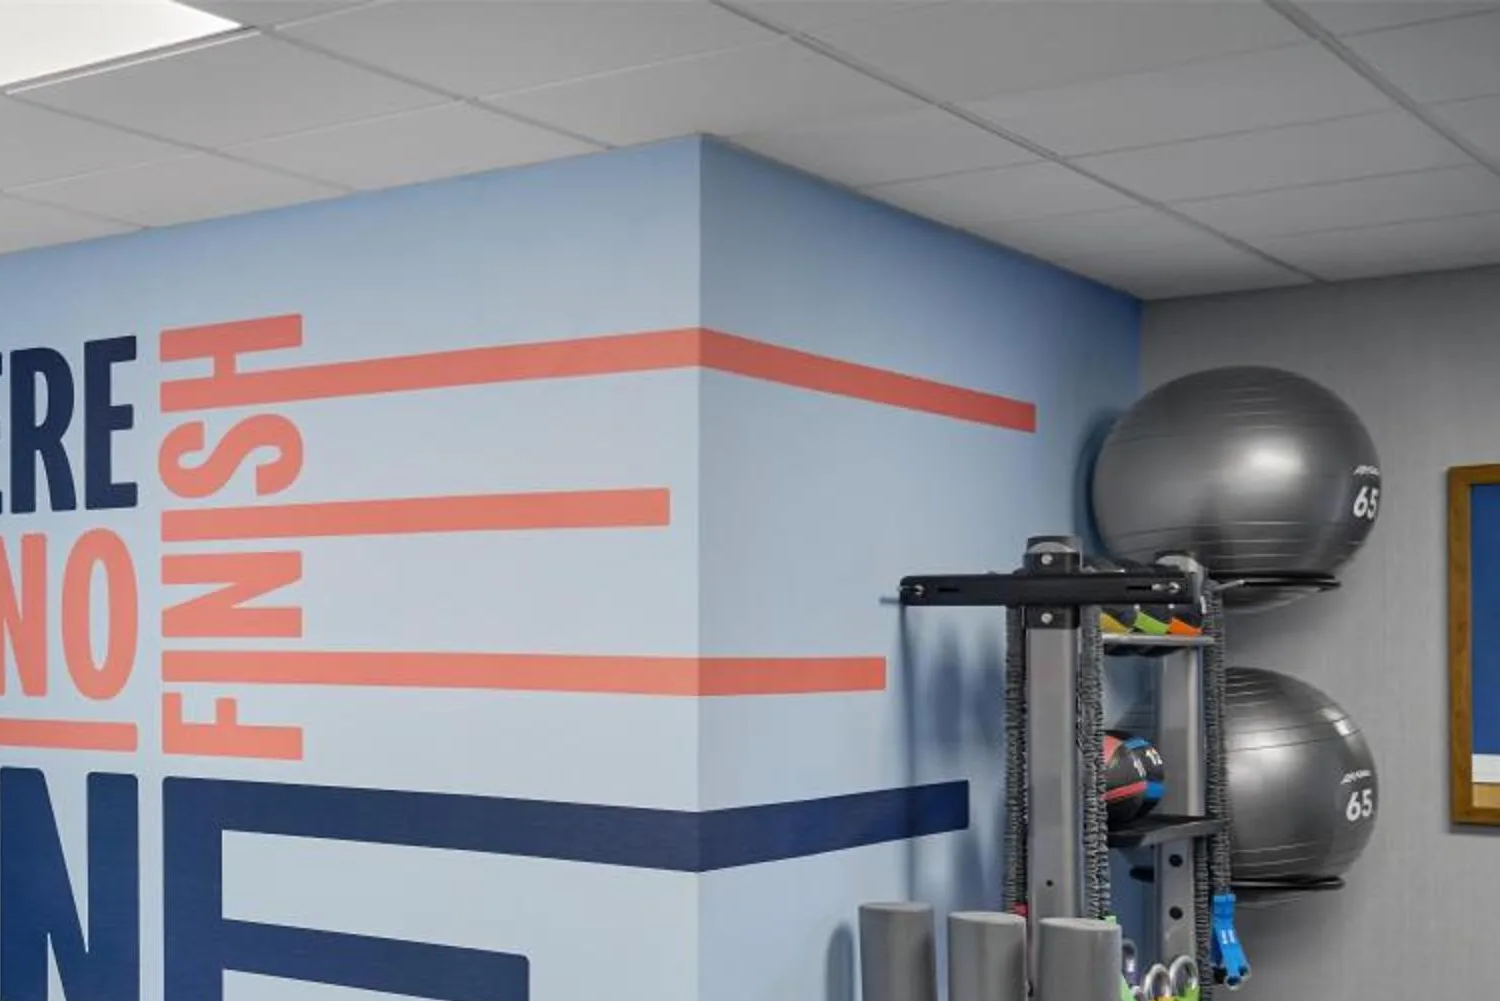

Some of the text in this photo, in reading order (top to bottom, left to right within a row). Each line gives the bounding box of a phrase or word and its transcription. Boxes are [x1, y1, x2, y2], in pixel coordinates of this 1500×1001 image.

[1353, 485, 1380, 519] 65
[160, 313, 304, 761] FINISH
[1346, 788, 1373, 822] 65
